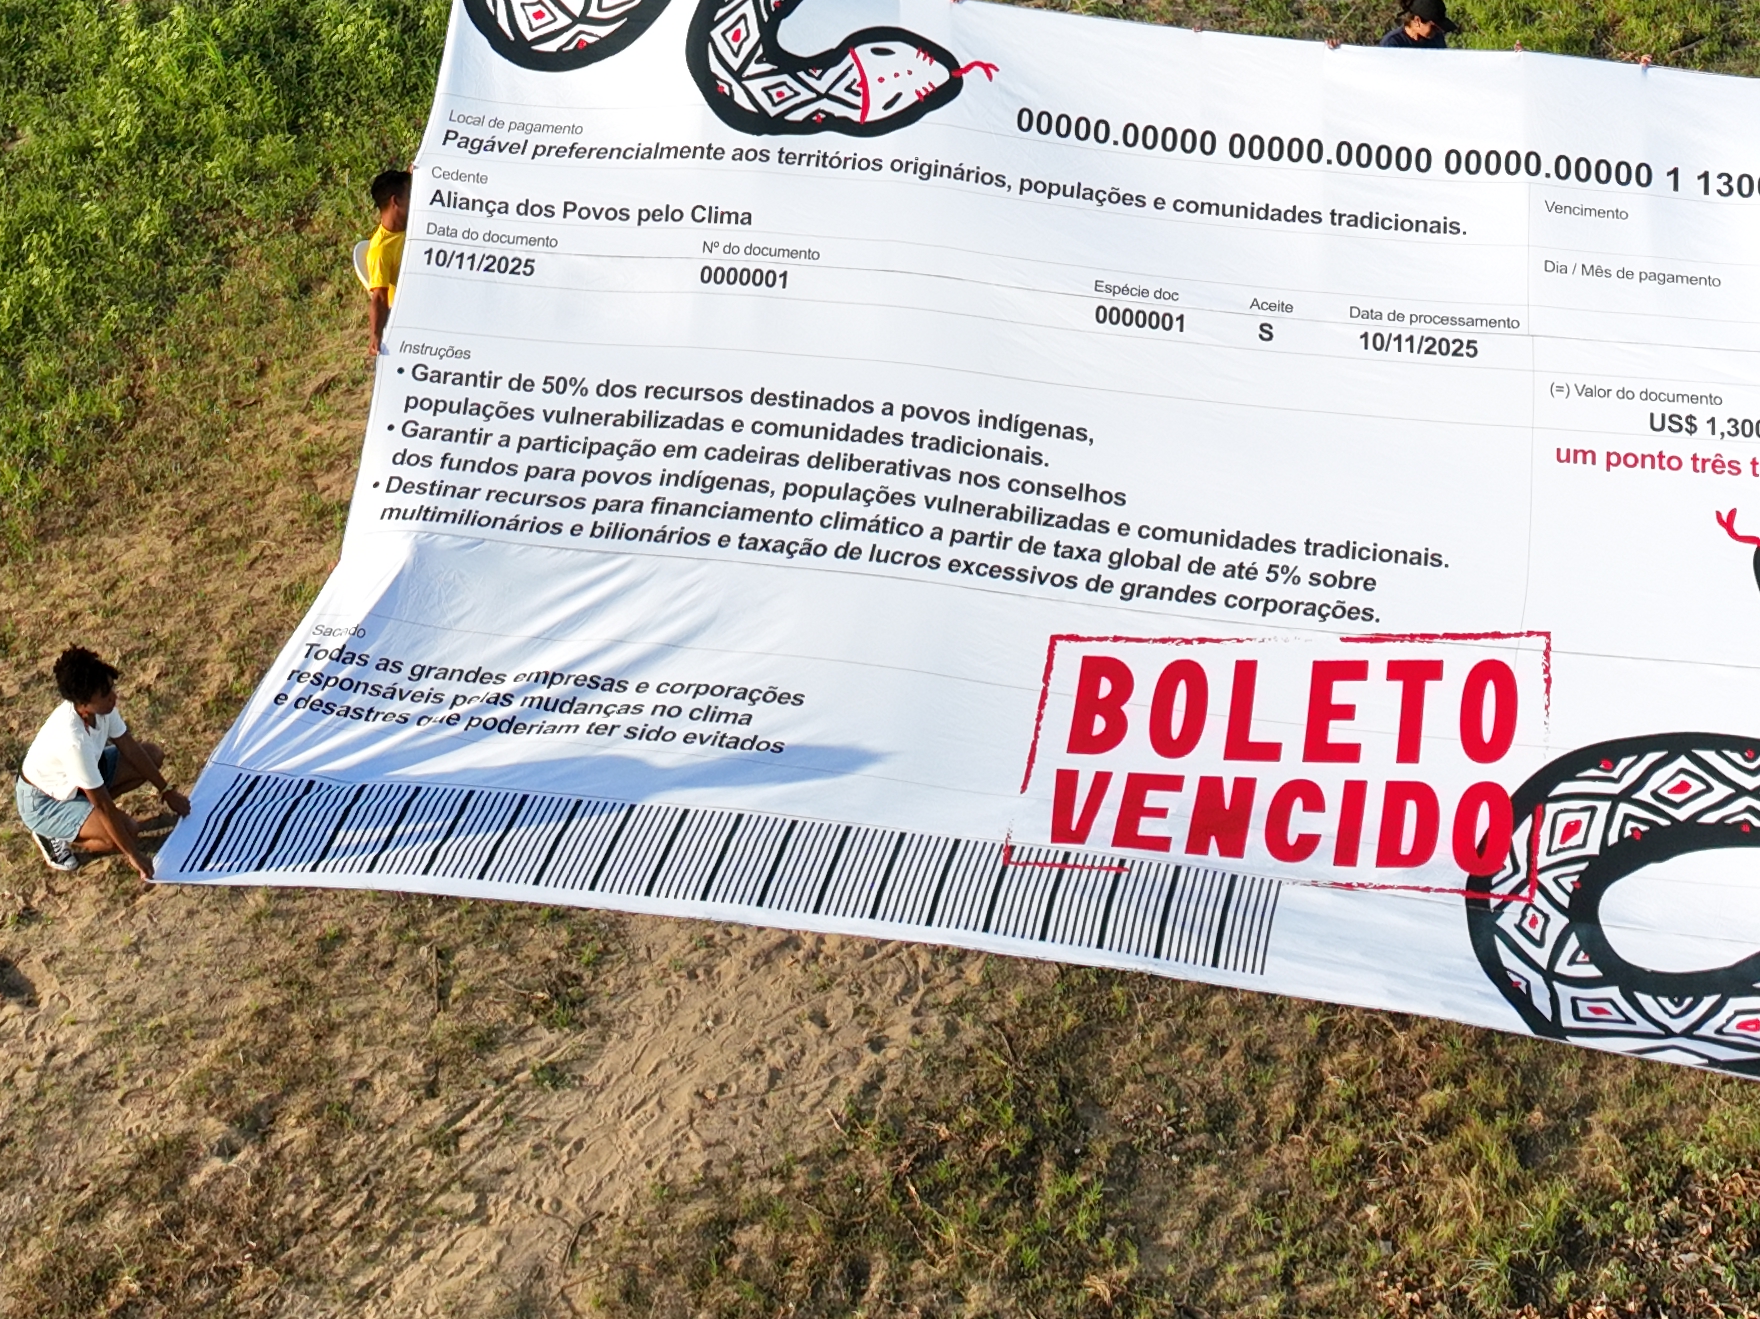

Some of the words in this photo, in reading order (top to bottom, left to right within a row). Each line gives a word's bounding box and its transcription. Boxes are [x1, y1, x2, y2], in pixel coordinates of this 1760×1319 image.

[449, 109, 485, 127] Local
[488, 117, 505, 129] de
[507, 121, 583, 135] pagamento
[1017, 107, 1217, 156] 00000.00000
[1229, 133, 1432, 173] 00000.00000
[1444, 149, 1653, 188] 00000.00000
[1666, 167, 1679, 192] 1
[432, 166, 488, 184] Cedente
[442, 129, 529, 155] Pagável
[531, 142, 725, 161] preferencialmente
[731, 148, 771, 163] aos
[777, 147, 883, 172] territórios
[890, 157, 1012, 192] originários,
[1019, 178, 1147, 208] populações
[1153, 197, 1166, 210] e
[1172, 199, 1323, 225] comunidades
[1329, 209, 1467, 235] tradicionais.
[429, 189, 509, 218] Aliança
[516, 198, 555, 218] dos
[562, 201, 630, 222] Povos
[637, 204, 684, 226] pelo
[691, 205, 752, 226] Clima
[1545, 200, 1629, 220] Vencimento
[426, 222, 458, 238] Data
[462, 228, 479, 241] do
[482, 230, 558, 248] documento
[424, 246, 535, 277] 10/11/2025
[702, 241, 720, 254] Nº
[723, 242, 740, 255] do
[744, 243, 820, 260] documento
[700, 265, 788, 289] 0000001
[1544, 260, 1568, 274] Dia
[1572, 263, 1577, 275] /
[1581, 263, 1612, 278] Mês
[1616, 267, 1634, 280] de
[1639, 271, 1721, 287] pagamento
[1094, 280, 1149, 302] Espécie
[1153, 288, 1179, 302] doc
[1095, 305, 1184, 333] 0000001
[1249, 298, 1294, 313] Aceite
[1350, 306, 1383, 320] Data
[1387, 310, 1405, 322] de
[1410, 314, 1520, 329] processamento
[1258, 322, 1274, 342] S
[1359, 331, 1478, 358] 10/11/2025
[399, 341, 471, 360] Instruções
[411, 363, 503, 389] Garantir
[508, 373, 535, 393] de
[542, 375, 589, 397] 50%
[596, 379, 637, 399] dos
[644, 385, 743, 404] recursos
[750, 387, 874, 414] destinados
[881, 402, 894, 417] a
[900, 404, 970, 426] povos
[977, 409, 1094, 446] indígenas,
[1550, 382, 1570, 399] (=)
[1574, 383, 1612, 398] Valor
[1616, 387, 1635, 400] do
[1639, 388, 1723, 405] documento
[404, 395, 535, 422] populações
[542, 406, 724, 432] vulnerabilizadas
[731, 419, 744, 433] e
[751, 420, 904, 447] comunidades
[911, 431, 1049, 467] tradicionais.
[1650, 412, 1698, 436] US$
[401, 420, 494, 446] Garantir
[497, 434, 511, 448] a
[516, 435, 657, 461] participação
[663, 444, 697, 460] em
[704, 444, 800, 467] cadeiras
[807, 450, 951, 482] deliberativas
[958, 470, 1000, 490] nos
[1007, 478, 1126, 507] conselhos
[1556, 447, 1596, 466] um
[1606, 450, 1683, 472] ponto
[1690, 452, 1742, 476] três
[392, 448, 433, 468] dos
[440, 452, 519, 477] fundos
[523, 465, 576, 483] para
[580, 469, 652, 488] povos
[659, 468, 775, 498] indígenas,
[782, 482, 916, 508] populações
[924, 494, 1110, 534] vulnerabilizadas
[1117, 522, 1131, 537] e
[1137, 525, 1297, 555] comunidades
[1304, 538, 1449, 568] tradicionais.
[385, 476, 482, 500] Destinar
[485, 489, 587, 510] recursos
[591, 498, 644, 515] para
[650, 496, 813, 527] financiamento
[820, 511, 924, 538] climático
[929, 526, 944, 541] a
[949, 528, 1013, 550] partir
[1018, 535, 1046, 556] de
[1053, 540, 1102, 563] taxa
[1107, 547, 1181, 572] global
[1187, 556, 1216, 576] de
[1222, 561, 1258, 581] até
[1265, 564, 1301, 586] 5%
[1308, 570, 1377, 592] sobre
[380, 504, 564, 536] multimilionários
[570, 523, 584, 537] e
[589, 520, 711, 547] bilionários
[717, 534, 731, 548] e
[738, 532, 828, 559] taxação
[834, 541, 862, 561] de
[868, 543, 941, 570] lucros
[948, 558, 1078, 590] excessivos
[1085, 574, 1114, 594] de
[1119, 582, 1217, 606] grandes
[1224, 594, 1380, 623] corporações.
[303, 643, 370, 667] Todas
[375, 656, 404, 674] as
[408, 663, 507, 686] grandes
[513, 670, 629, 694] empresas
[635, 680, 650, 694] e
[655, 680, 806, 707] corporações
[287, 668, 445, 705] responsáveis
[519, 694, 645, 718] mudanças
[650, 701, 683, 718] no
[688, 703, 753, 726] clima
[1067, 655, 1518, 764] BOLETO
[273, 691, 289, 706] e
[293, 694, 410, 725] desastres
[464, 716, 580, 738] poderiam
[585, 721, 622, 737] ter
[623, 723, 677, 743] sido
[682, 731, 786, 754] evitados
[1050, 768, 1514, 876] VENCIDO
